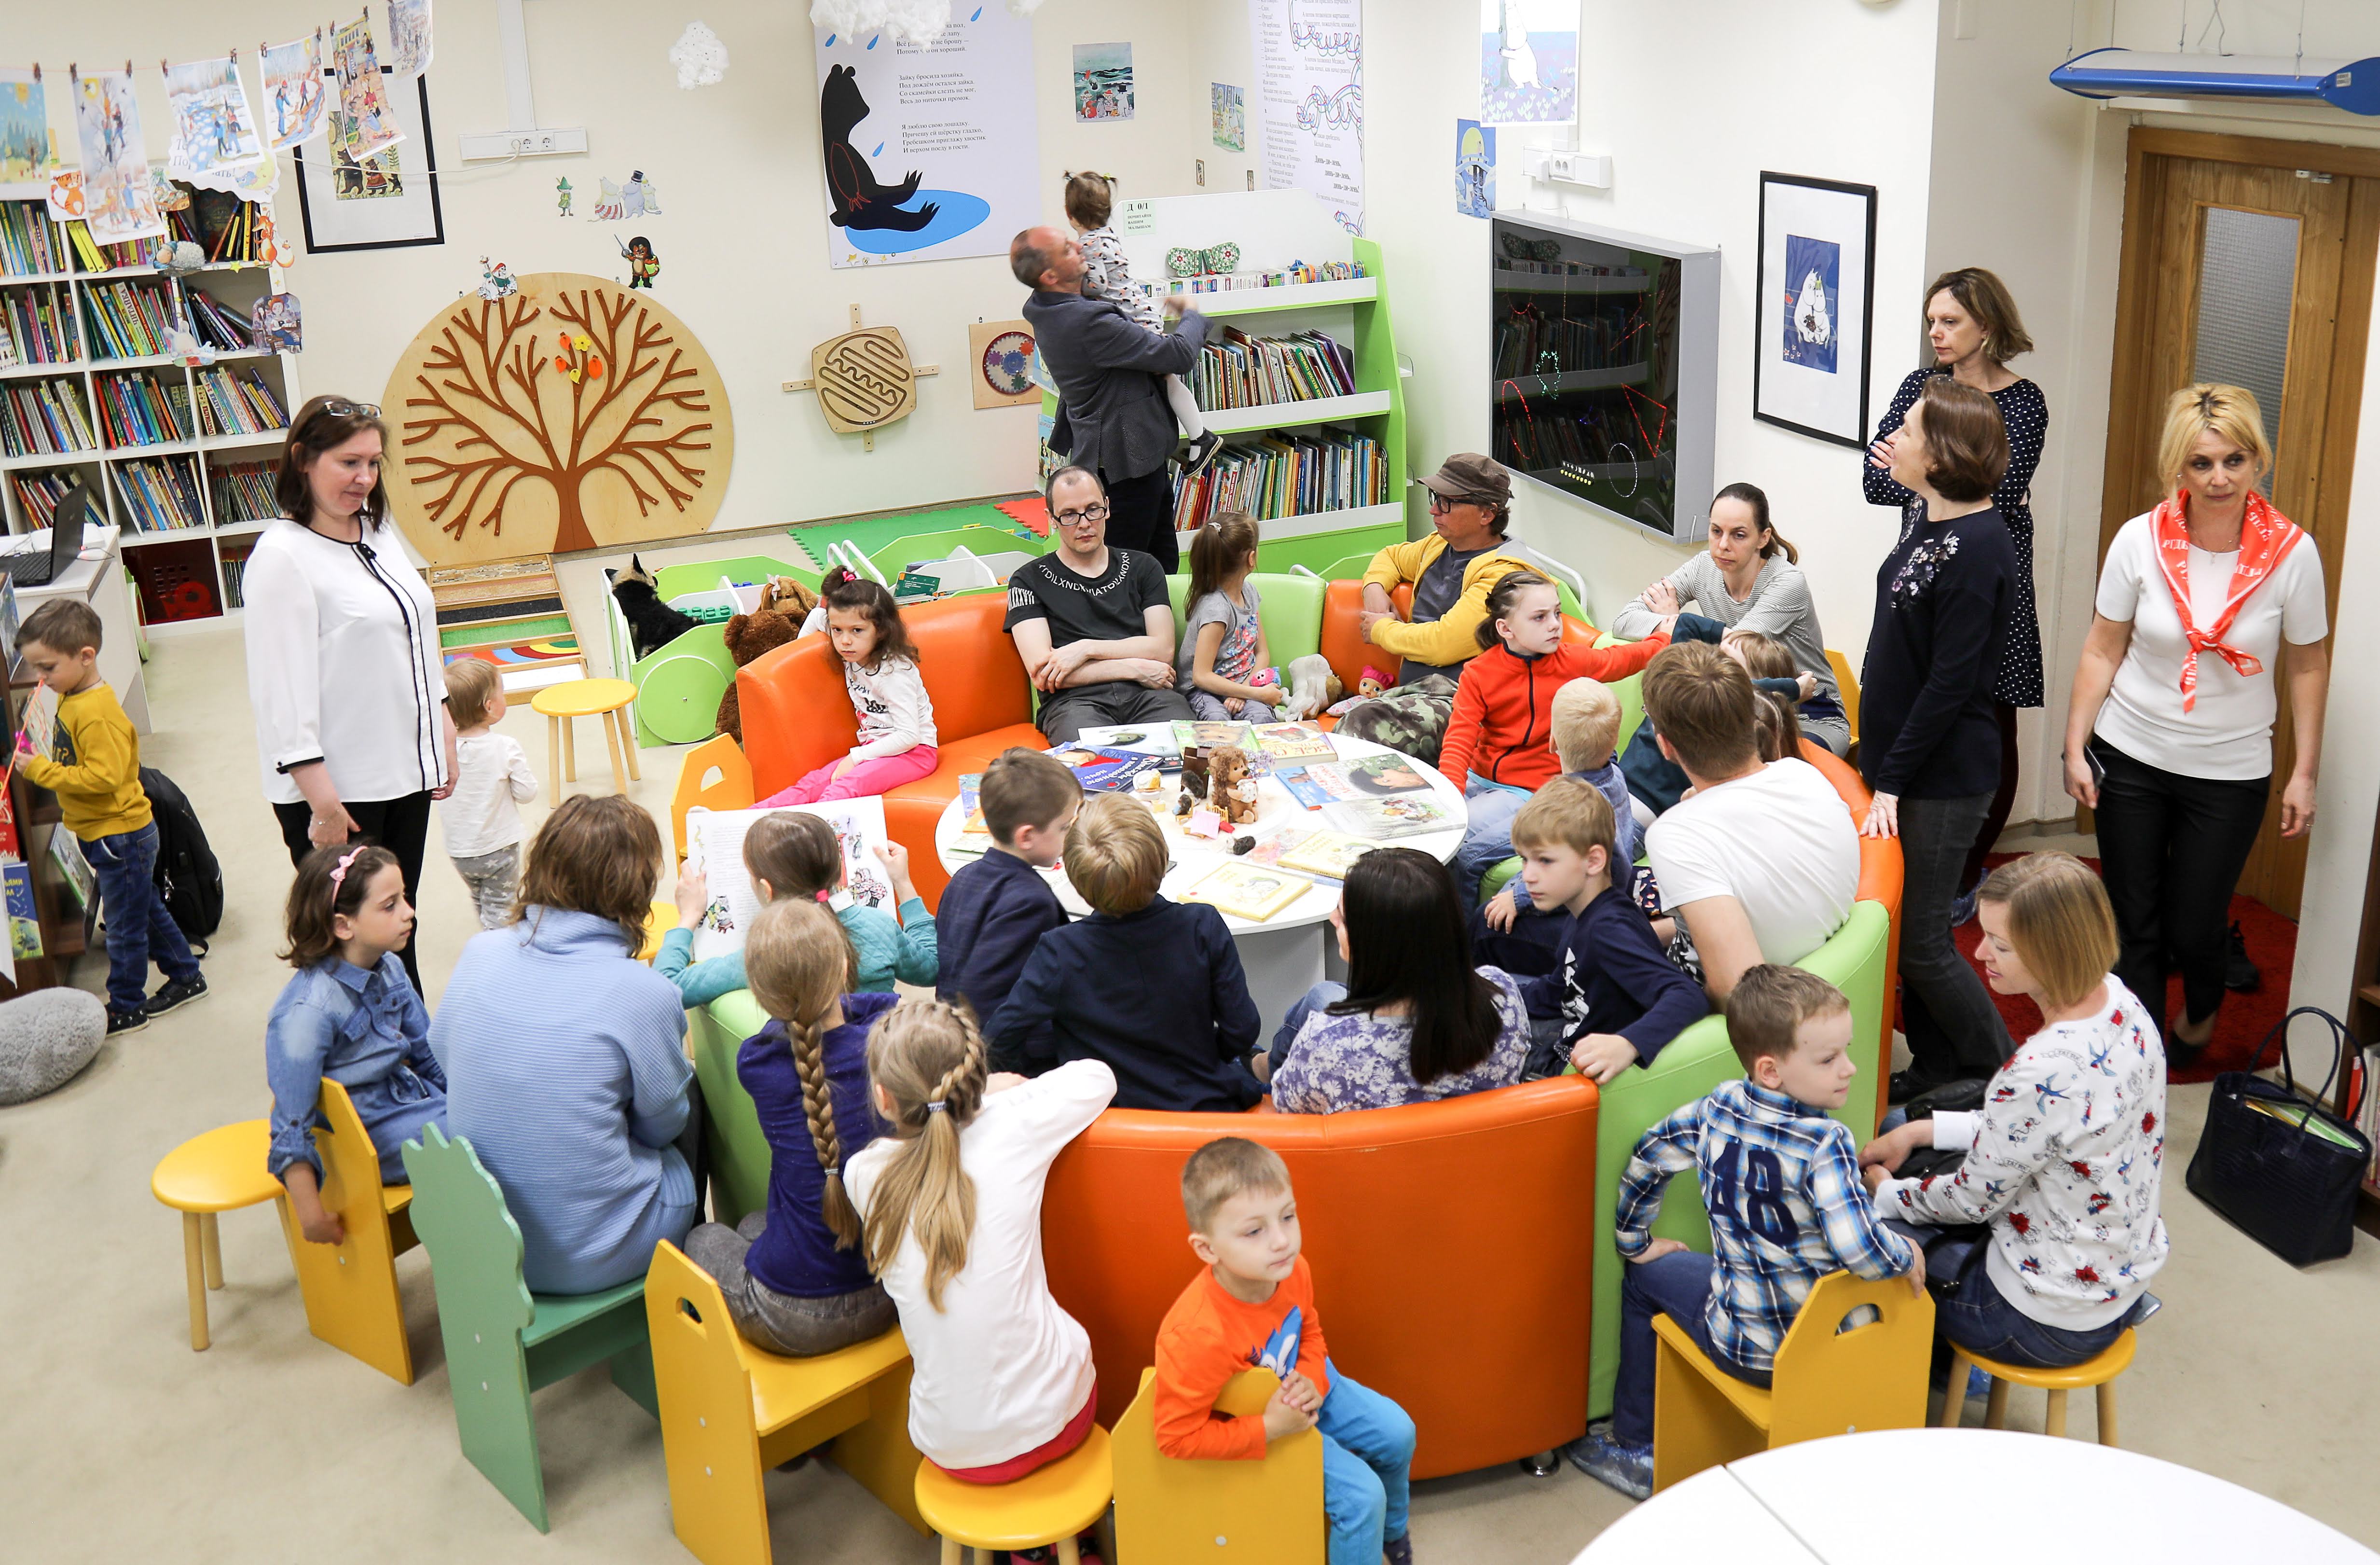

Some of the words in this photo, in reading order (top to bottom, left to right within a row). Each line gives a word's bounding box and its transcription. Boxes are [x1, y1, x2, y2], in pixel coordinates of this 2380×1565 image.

[212, 168, 235, 178] ать!
[120, 288, 138, 325] ЧИТАЙКА
[210, 393, 231, 435] ХРЕСТОМАТИЯ
[2162, 539, 2189, 550] РГДБ
[1086, 761, 1135, 785] новогоднюю
[1711, 1139, 1800, 1248] 18
